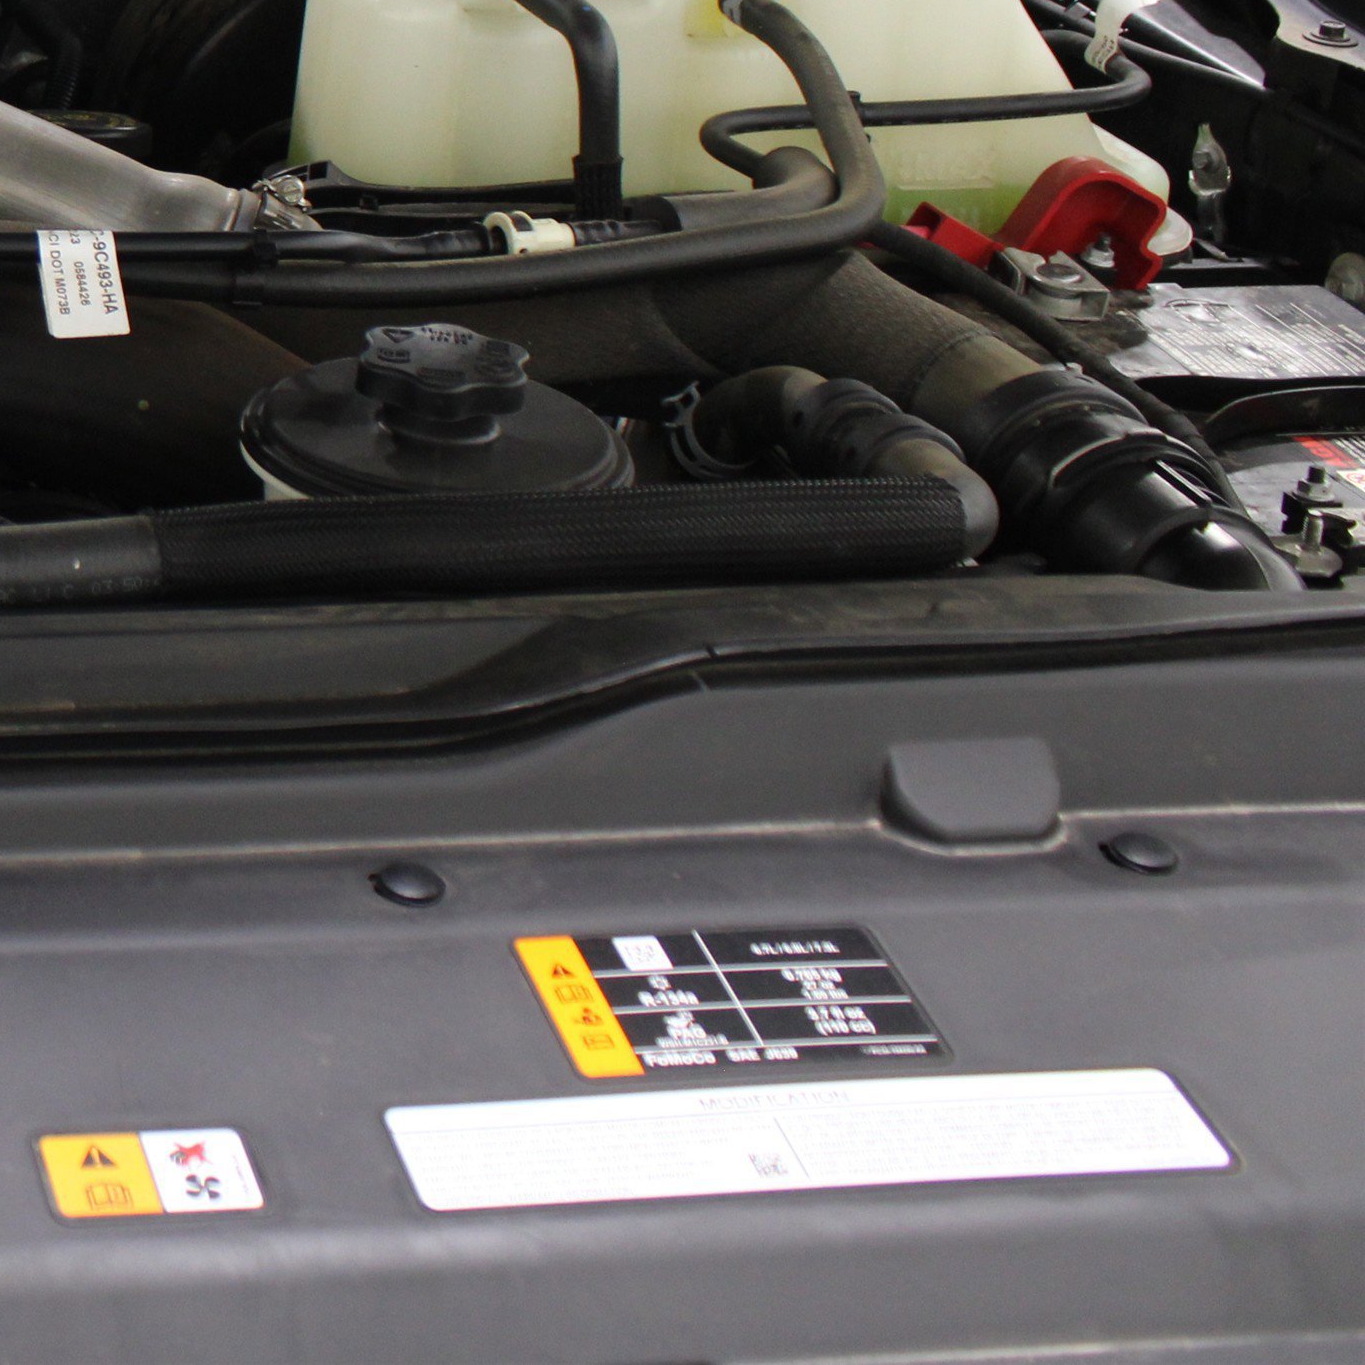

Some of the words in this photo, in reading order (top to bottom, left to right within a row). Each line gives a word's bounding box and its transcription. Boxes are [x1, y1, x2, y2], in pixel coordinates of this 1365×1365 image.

[50, 250, 64, 275] DOT
[637, 990, 700, 1007] R-134a
[641, 1050, 718, 1068] FoMoCo
